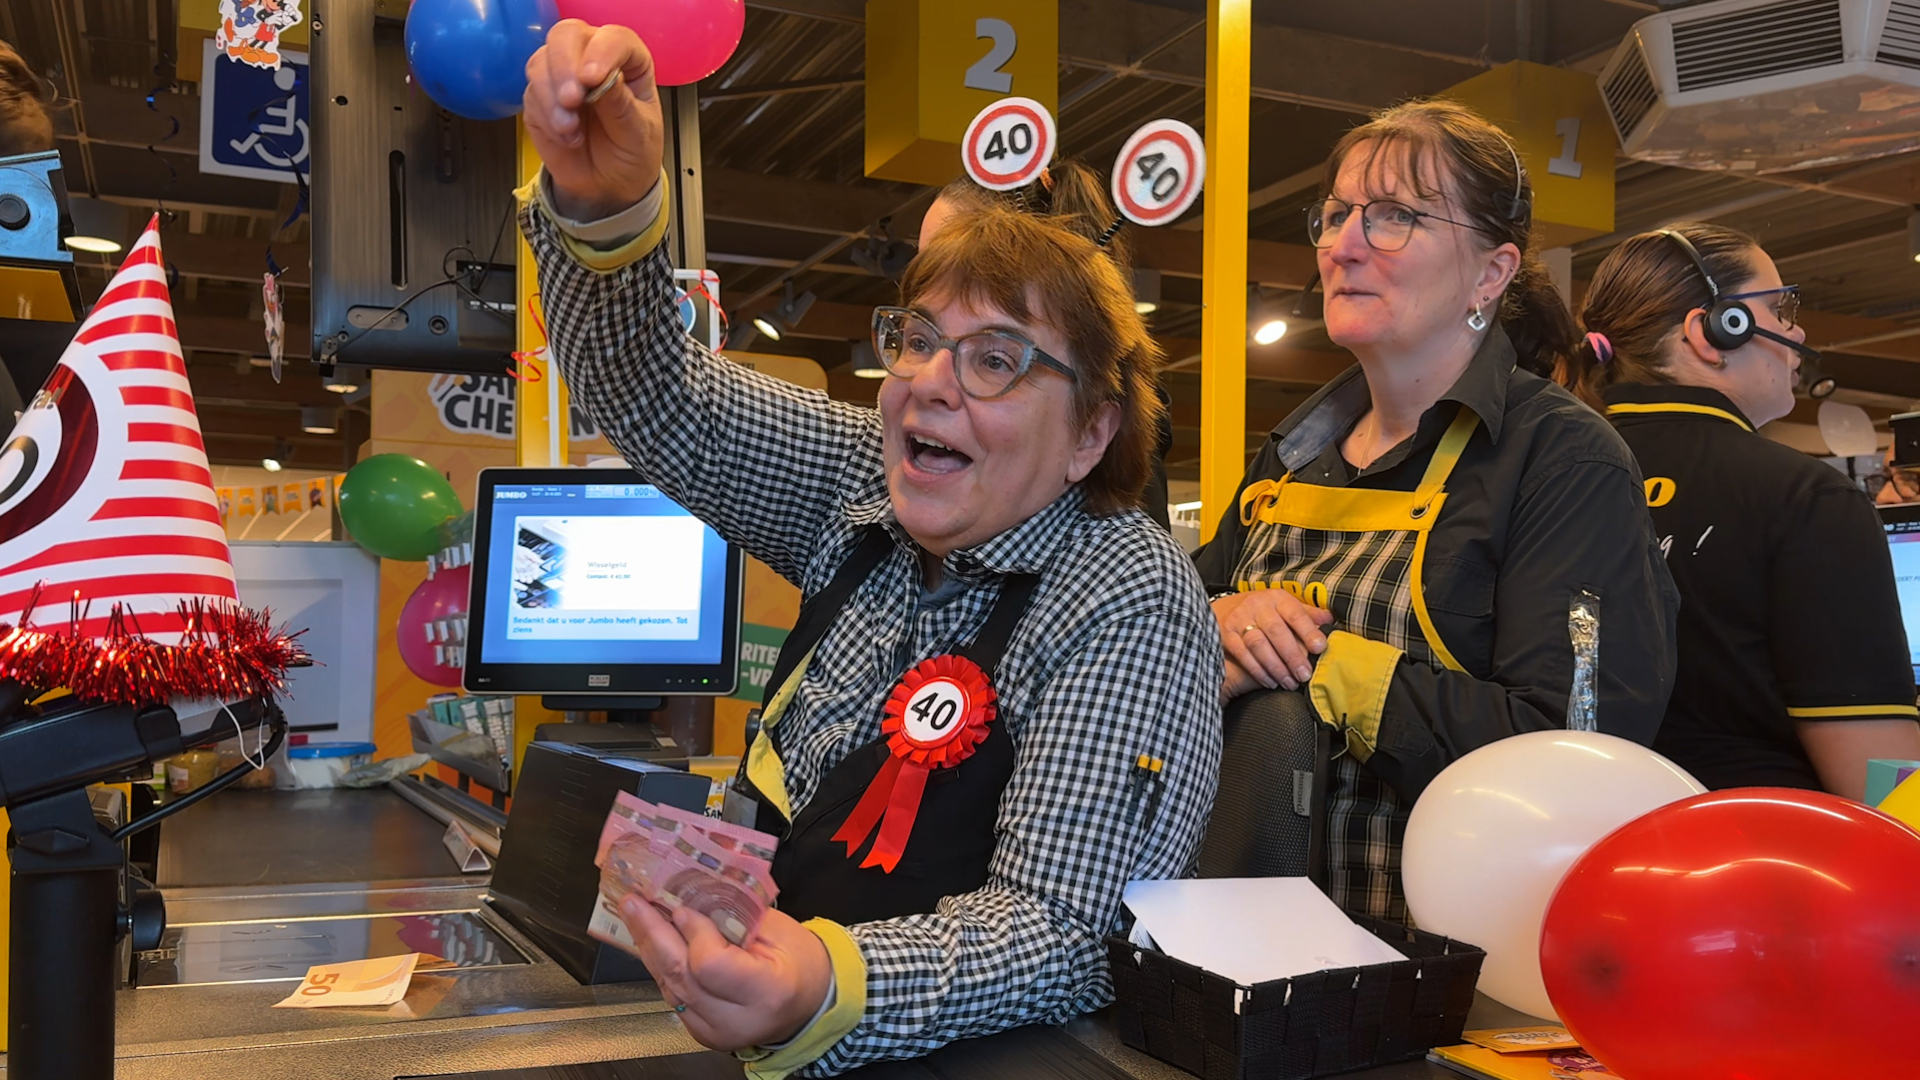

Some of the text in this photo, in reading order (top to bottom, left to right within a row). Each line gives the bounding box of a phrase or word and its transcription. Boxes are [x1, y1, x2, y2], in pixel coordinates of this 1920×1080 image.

[963, 17, 1017, 94] 2
[983, 122, 1032, 161] 40
[1547, 117, 1583, 179] 1
[1136, 151, 1180, 202] 40
[495, 491, 527, 499] JUMBO
[587, 561, 627, 569] Wisselgeld
[513, 616, 544, 624] Bedankt
[547, 616, 560, 624] dat
[587, 616, 614, 624] Jumbo
[616, 616, 637, 624] heeft
[639, 616, 673, 626] gekozen.
[676, 616, 688, 624] Tot
[910, 692, 957, 731] 40
[300, 972, 341, 996] 50
